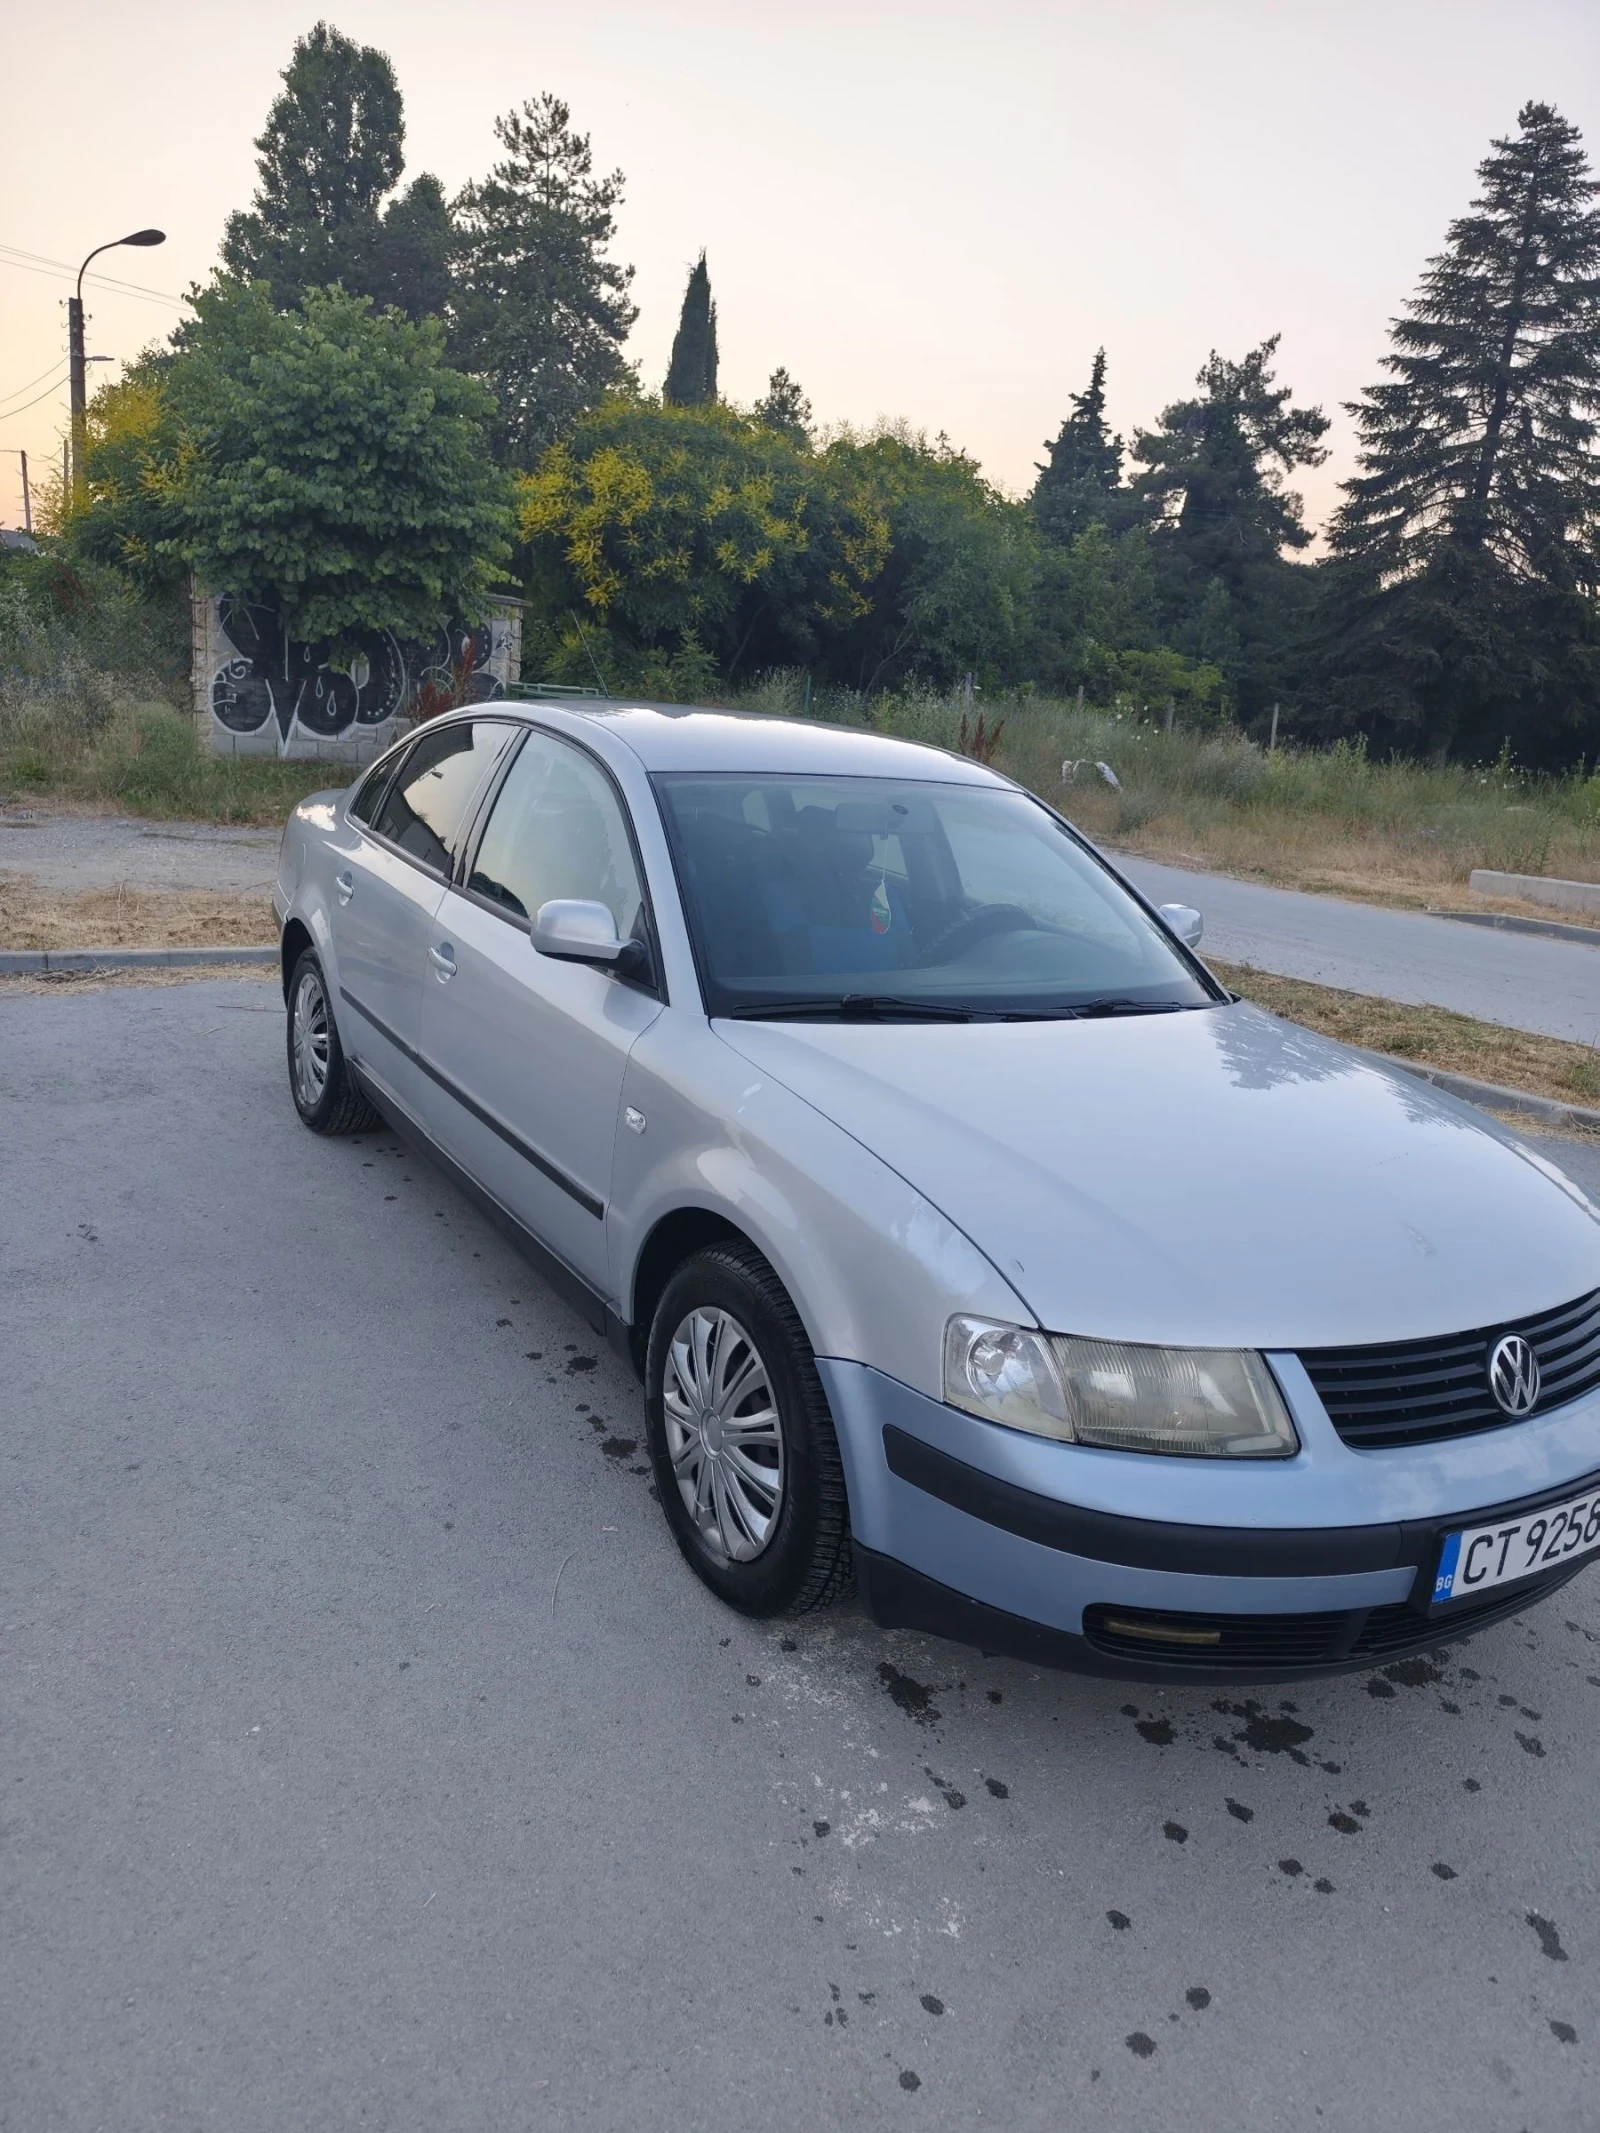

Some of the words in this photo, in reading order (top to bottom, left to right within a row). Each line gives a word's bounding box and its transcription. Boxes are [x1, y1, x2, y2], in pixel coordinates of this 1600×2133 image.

[1490, 1335, 1540, 1416] VW
[1435, 1574, 1453, 1592] BG
[1463, 1526, 1521, 1585] CT
